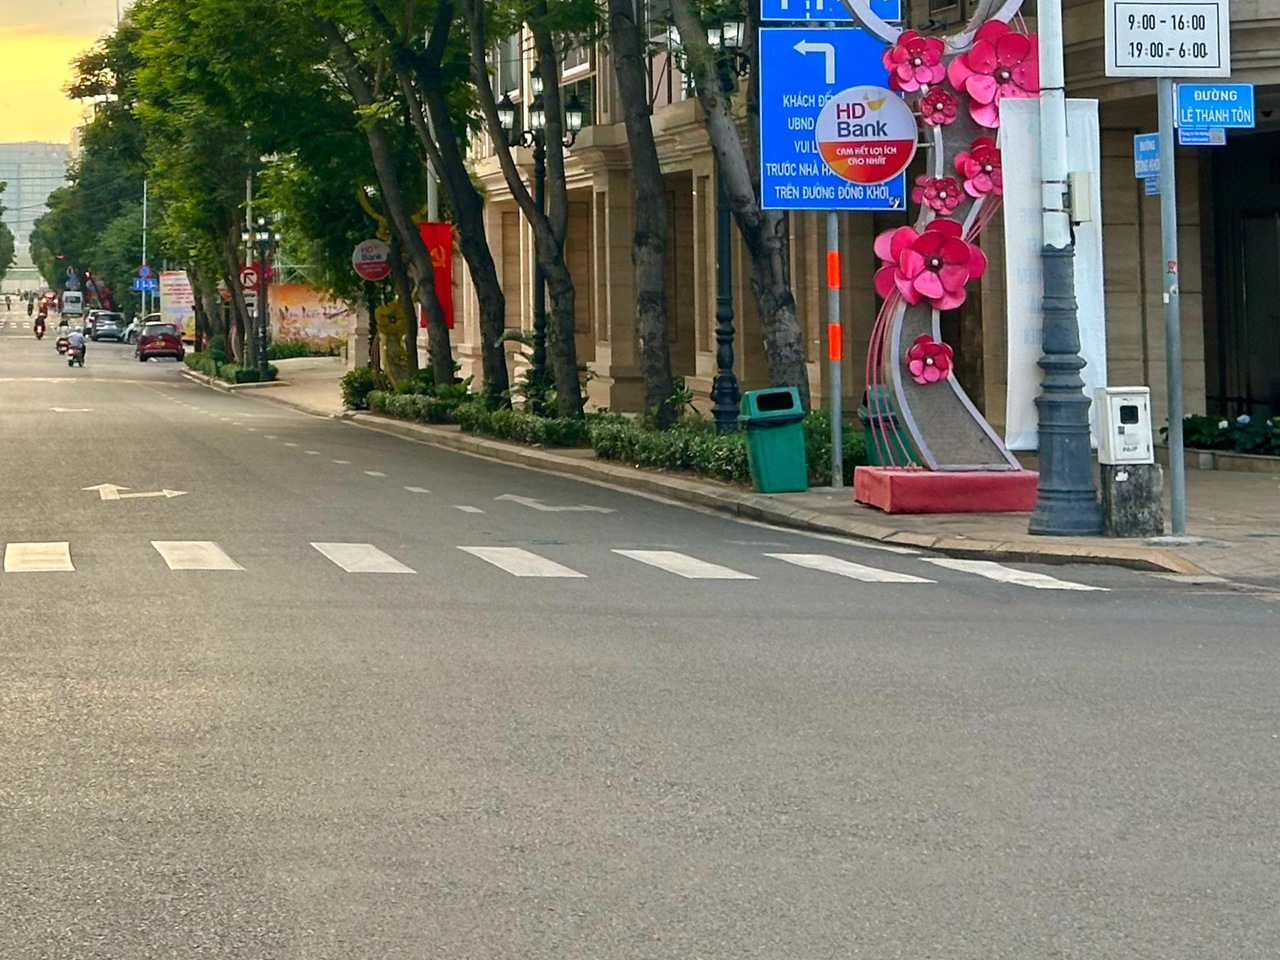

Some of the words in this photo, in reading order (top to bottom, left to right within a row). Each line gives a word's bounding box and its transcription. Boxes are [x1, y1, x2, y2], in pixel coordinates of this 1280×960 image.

[1128, 14, 1155, 30] 9:00
[1171, 14, 1205, 30] 16:00
[1129, 42, 1163, 58] 19:00
[1179, 42, 1206, 58] 6:00
[783, 91, 815, 107] KHÁCH
[1194, 88, 1238, 101] ĐƯỜNG
[836, 103, 866, 120] HD
[1181, 105, 1193, 123] LÊ
[1195, 105, 1229, 123] THÁNH
[1231, 105, 1251, 123] TÔN
[788, 117, 815, 130] UBND
[837, 120, 888, 138] Bank
[794, 141, 809, 153] VUI
[766, 160, 796, 176] TRƯỚC
[799, 159, 819, 176] NHÀ
[775, 183, 800, 199] TRÊN
[802, 183, 835, 199] ĐƯỜNG
[838, 182, 864, 199] ĐỒNG
